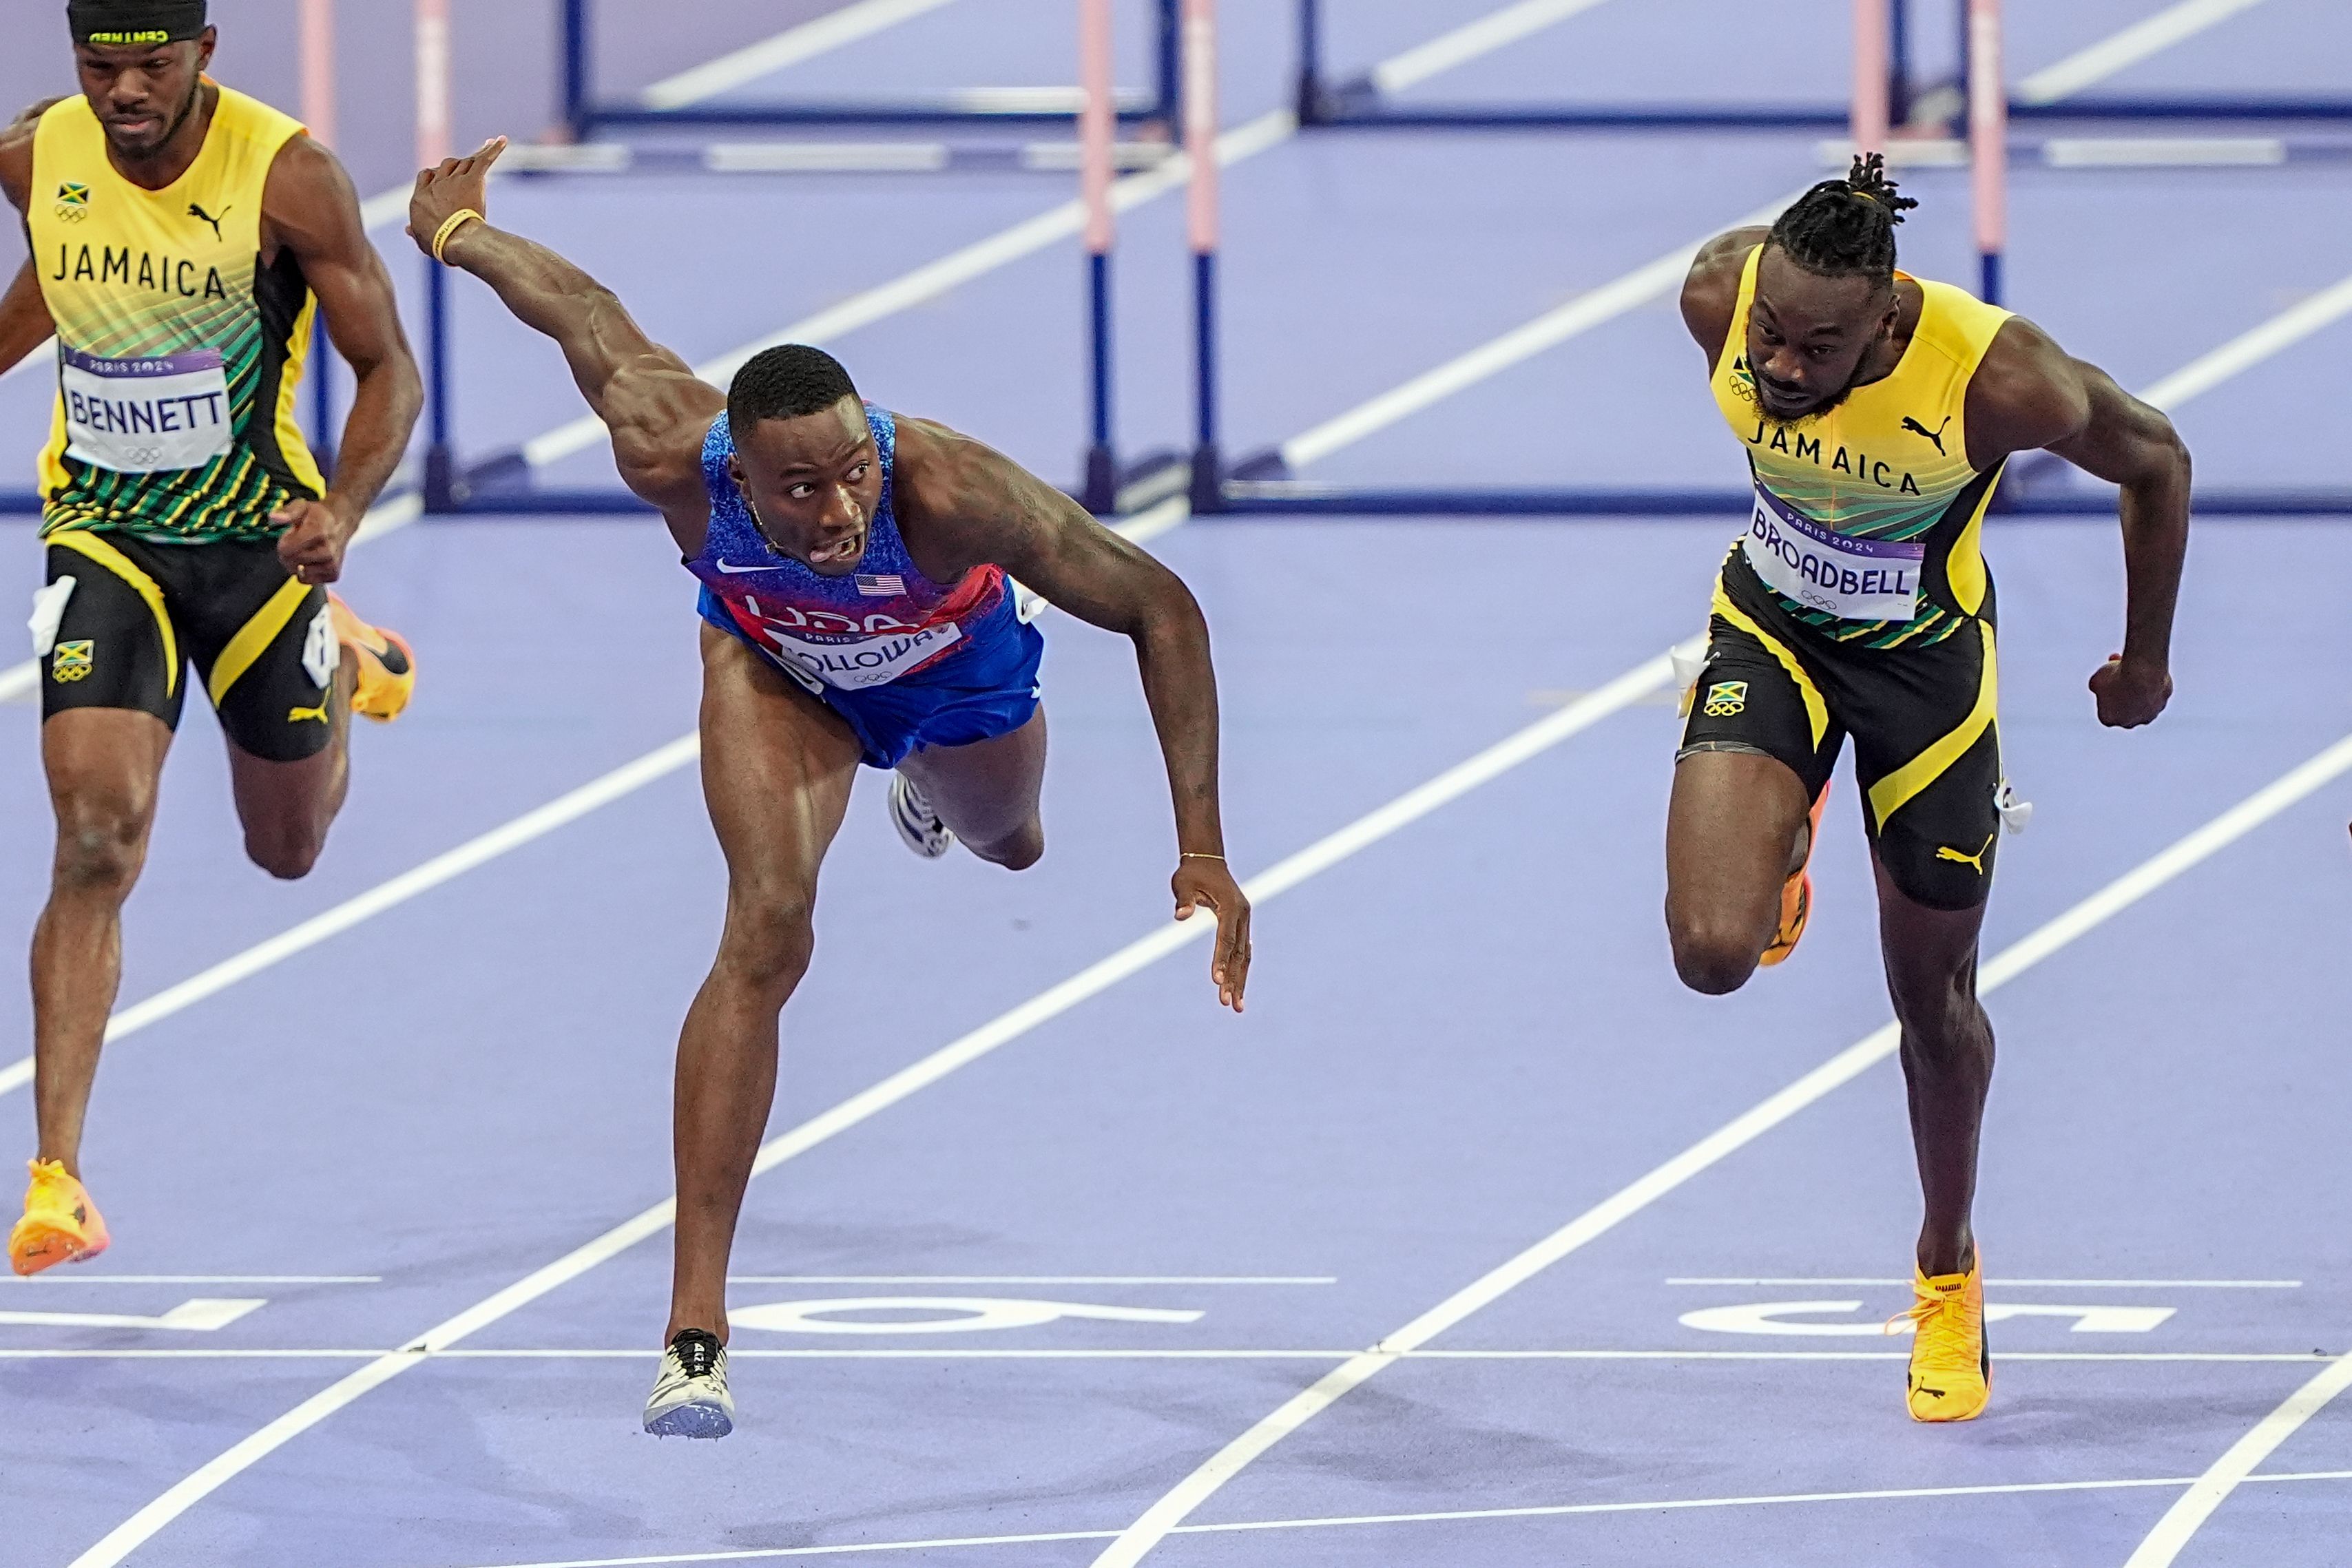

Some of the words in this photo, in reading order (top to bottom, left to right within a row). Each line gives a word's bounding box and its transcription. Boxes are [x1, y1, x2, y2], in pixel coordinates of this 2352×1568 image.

[54, 243, 226, 300] JAMAICA
[90, 359, 129, 373] PARIS
[131, 360, 174, 373] 2024
[71, 390, 222, 434] BENNETT
[1748, 420, 1921, 496] JAMAICA
[1753, 505, 1910, 595] BROADBELL
[1787, 512, 1827, 540] PARIS
[1832, 536, 1874, 553] 2024
[745, 595, 921, 633] USA
[793, 626, 945, 672] OLLOWA
[804, 633, 850, 643] PARIS
